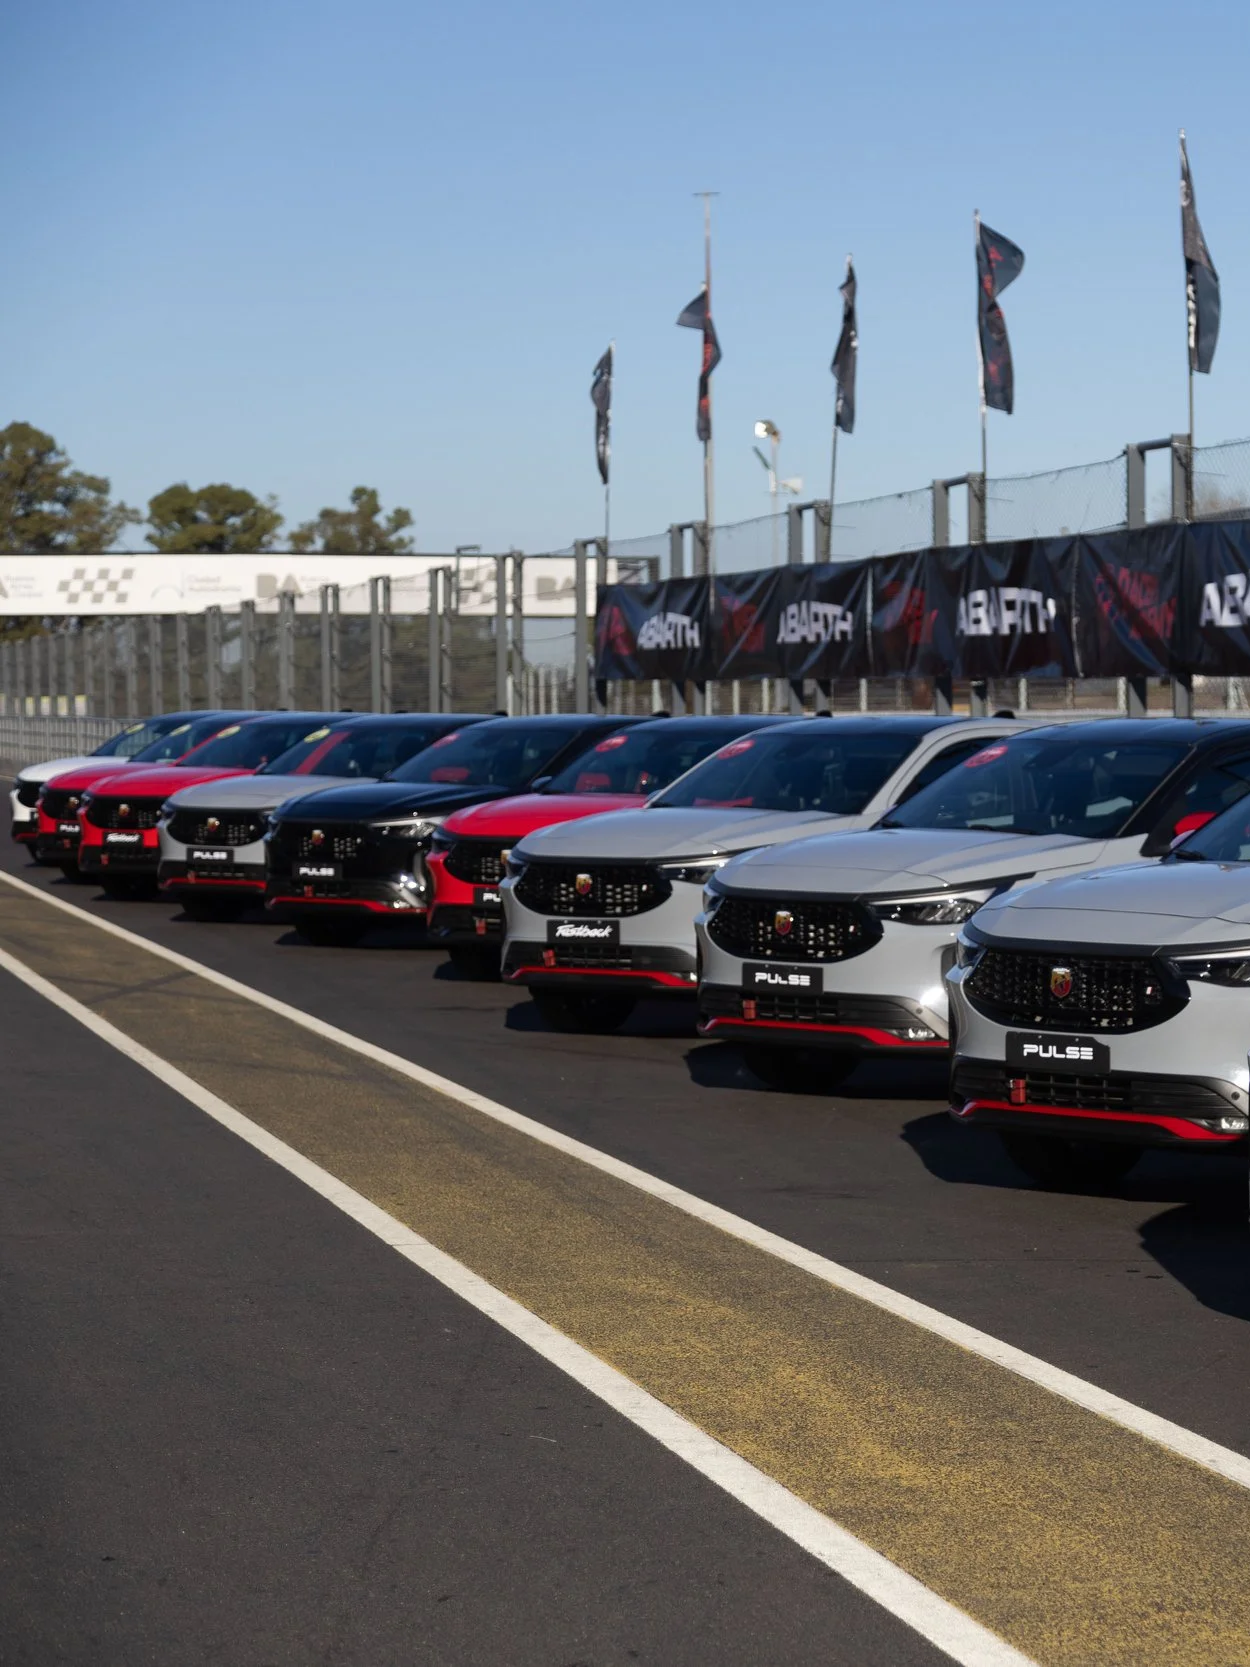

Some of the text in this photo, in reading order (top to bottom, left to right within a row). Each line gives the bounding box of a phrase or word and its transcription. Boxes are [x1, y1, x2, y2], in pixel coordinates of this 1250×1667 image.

[955, 587, 1057, 636] ABARTH
[638, 612, 701, 649] ABARTH
[777, 600, 853, 644] ABARTH
[299, 867, 335, 876] PULSE
[555, 924, 613, 938] Fastback
[755, 972, 811, 986] PULSE
[1023, 1043, 1094, 1060] PULSE
